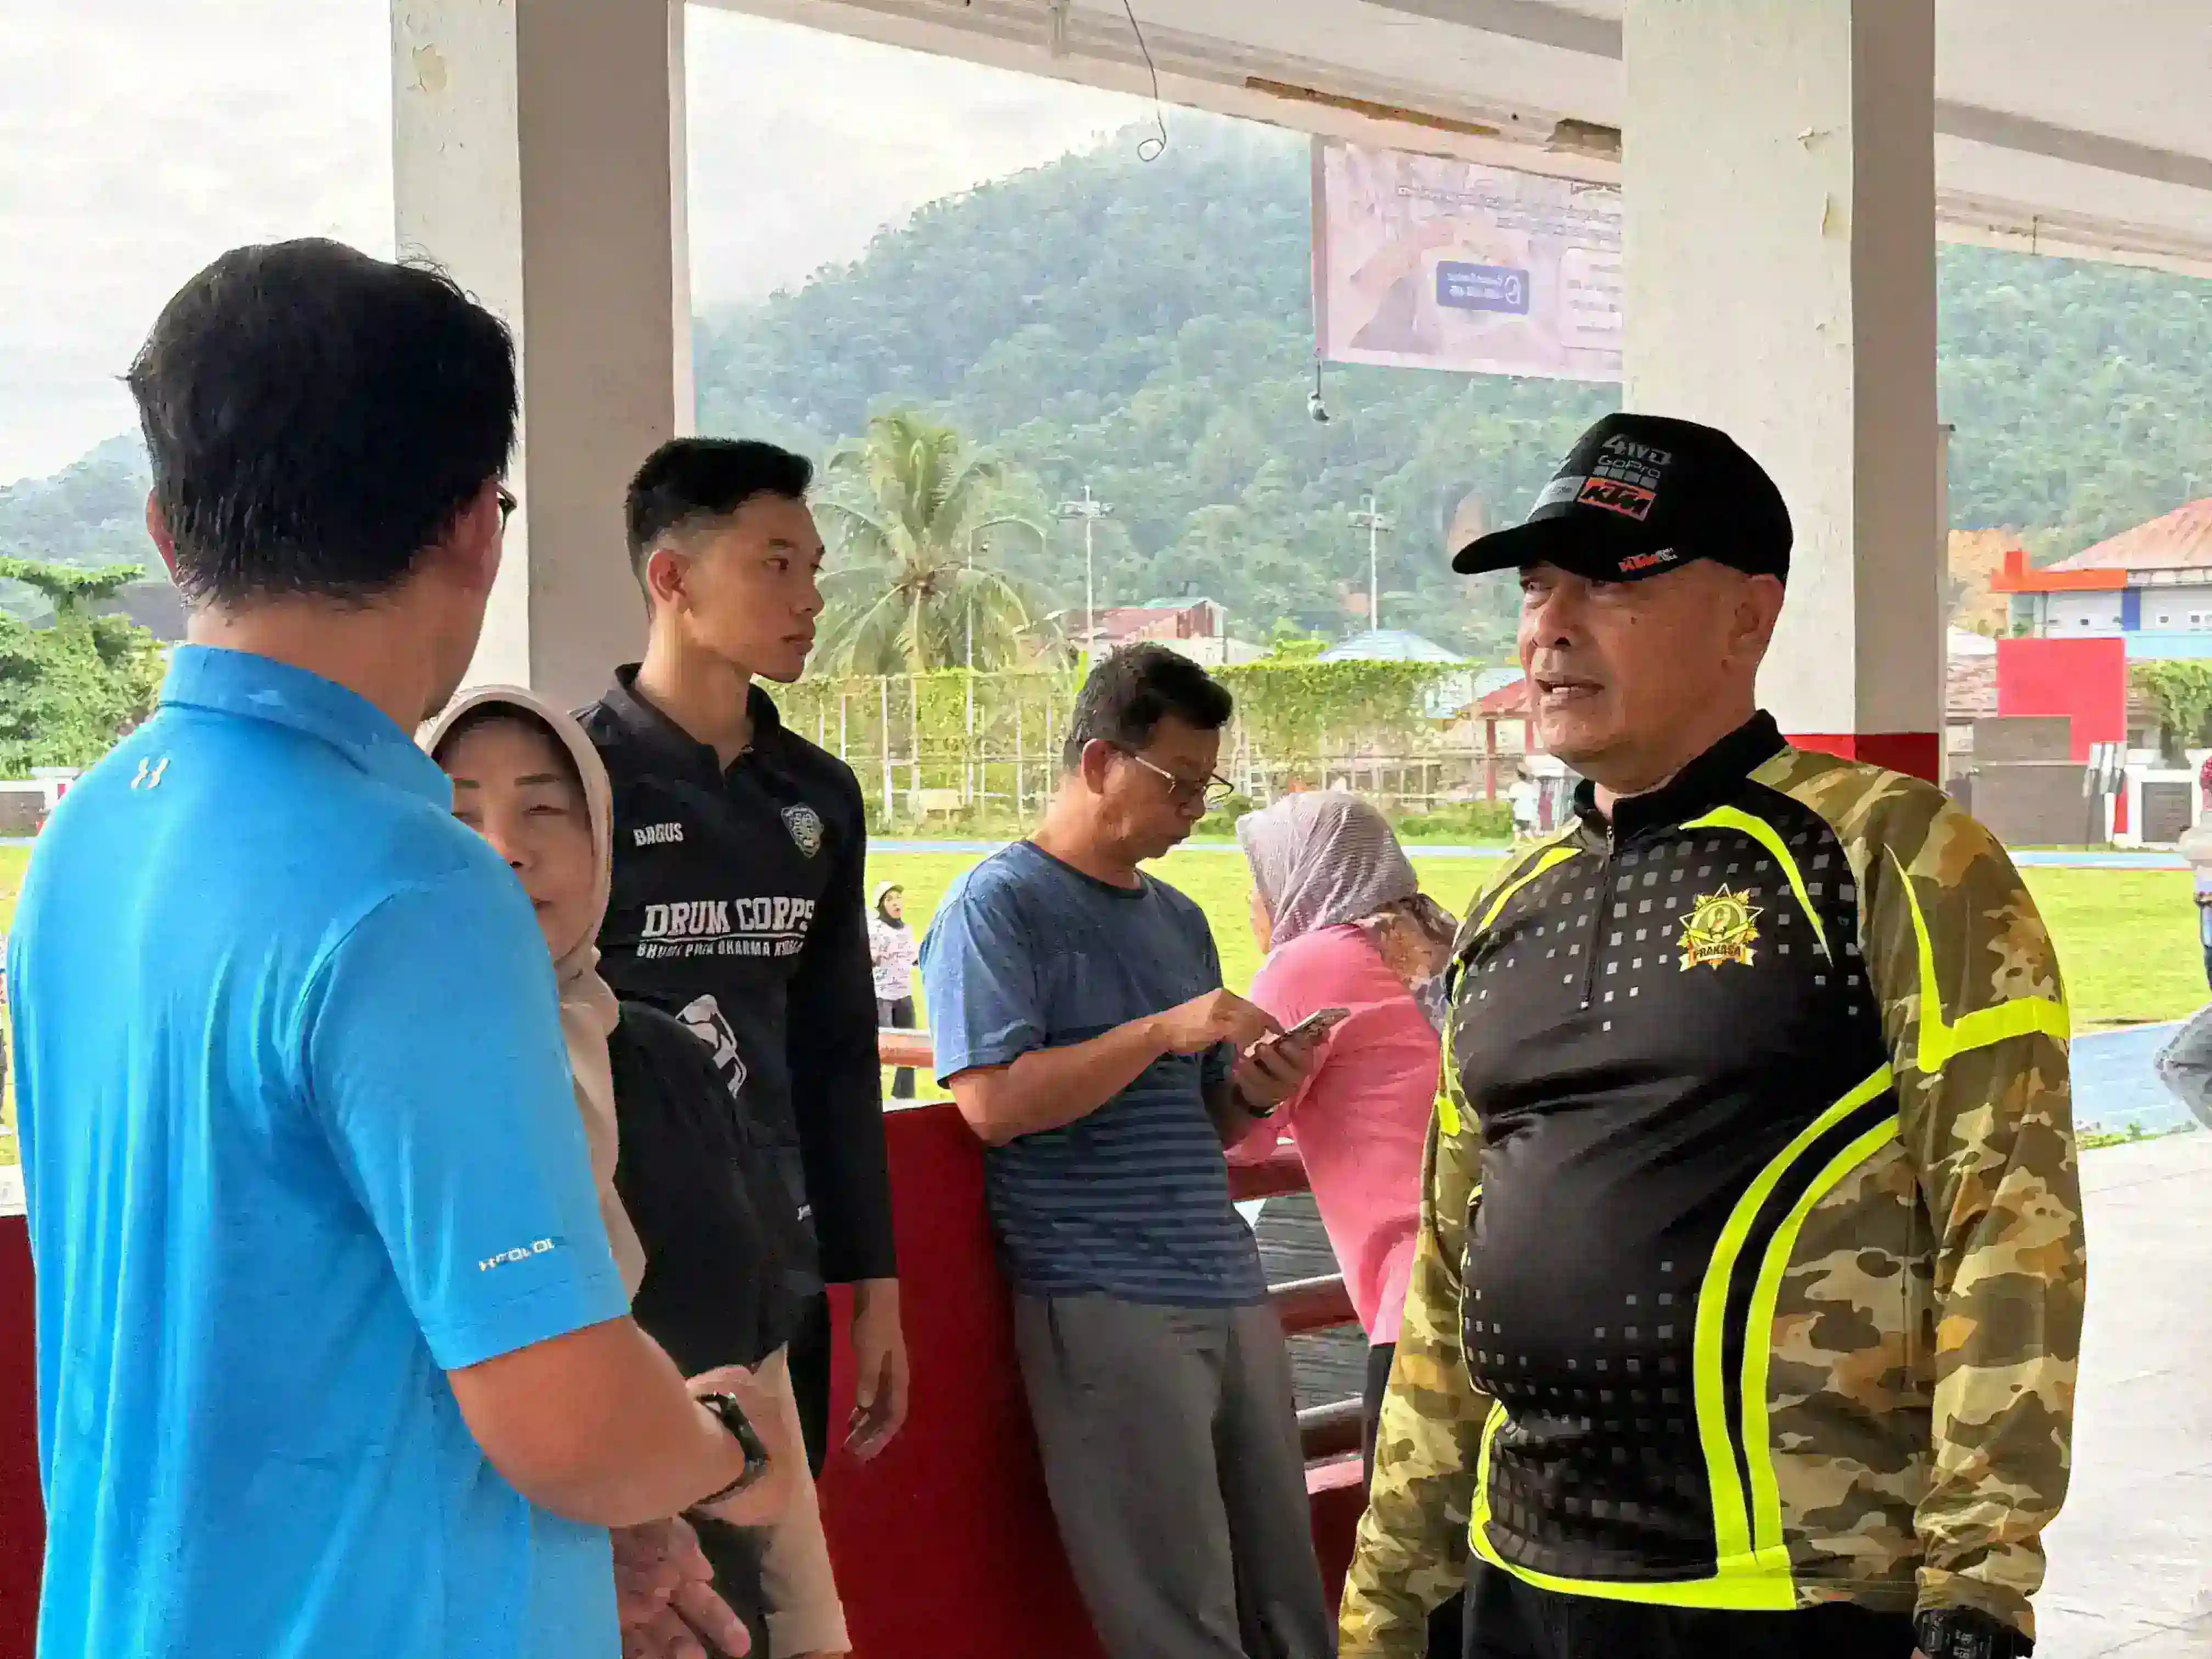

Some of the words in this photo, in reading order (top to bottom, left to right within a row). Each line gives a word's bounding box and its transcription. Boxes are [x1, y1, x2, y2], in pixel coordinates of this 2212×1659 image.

[633, 822, 685, 847] BAGUS
[641, 900, 731, 938] DRUM
[735, 896, 816, 932] CORPS
